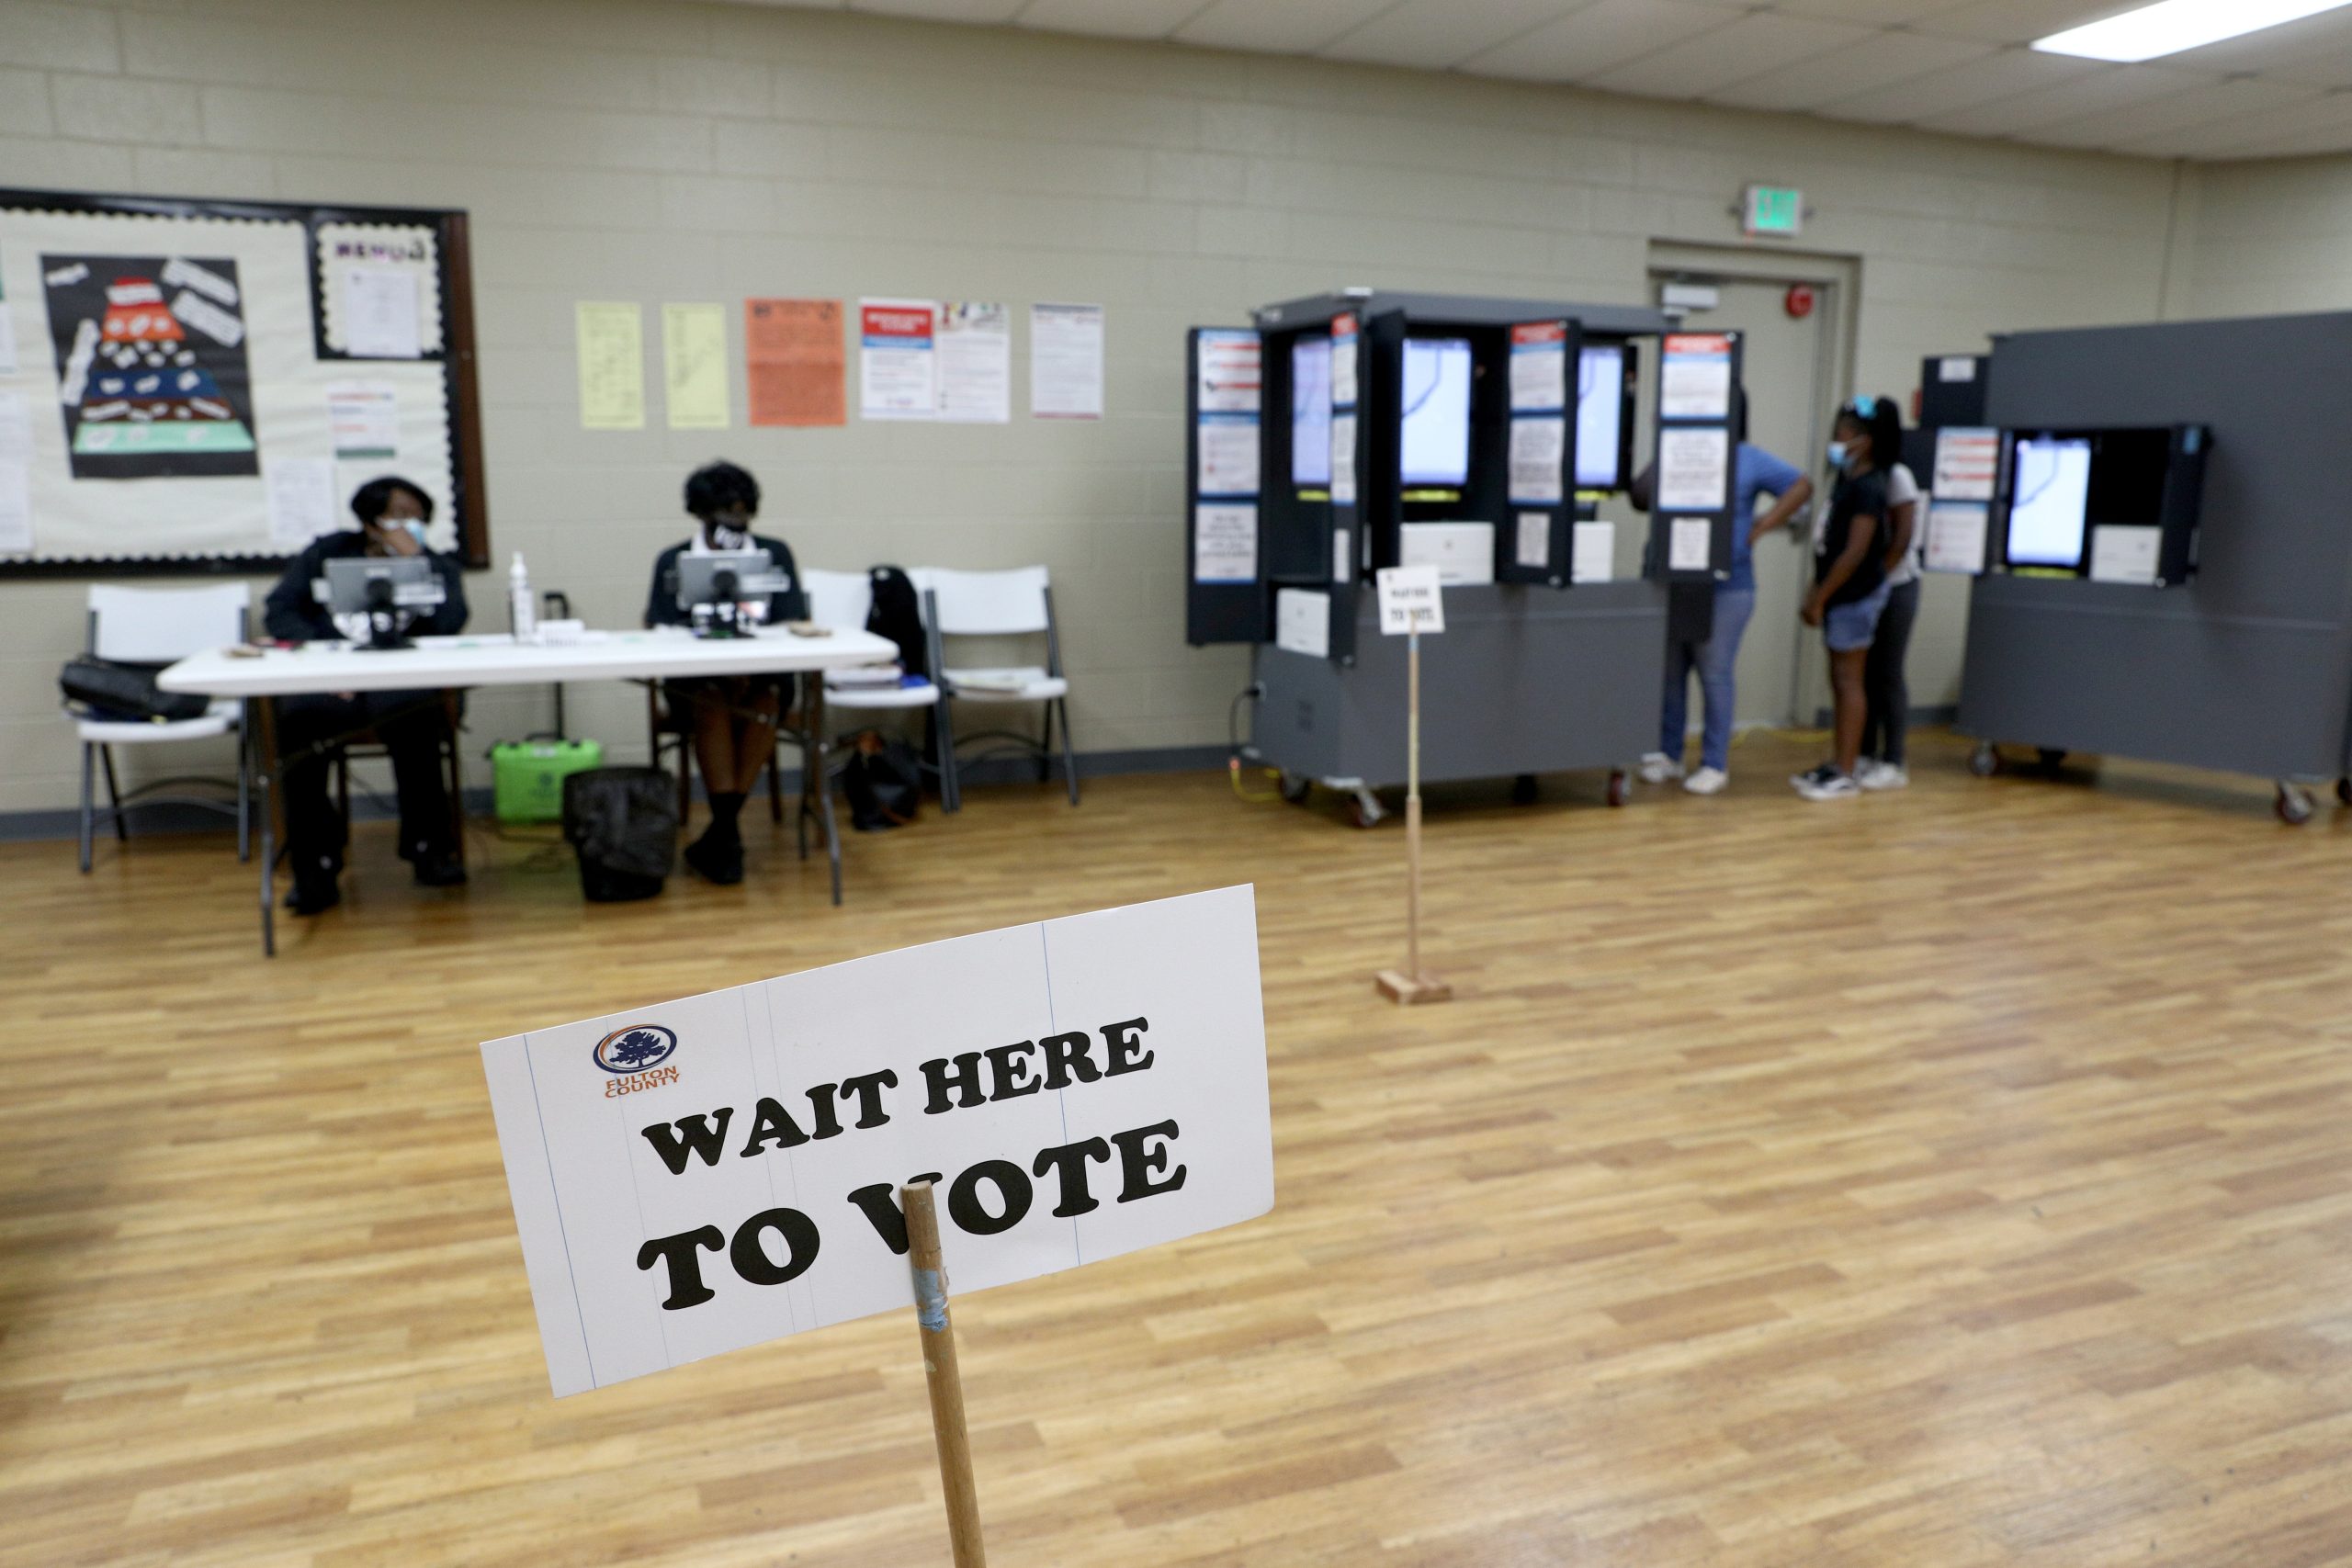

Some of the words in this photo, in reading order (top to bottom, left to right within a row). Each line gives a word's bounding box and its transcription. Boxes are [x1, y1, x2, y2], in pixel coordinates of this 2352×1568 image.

[605, 1073, 680, 1098] COUNTY
[606, 1066, 677, 1089] FULTON
[641, 1068, 899, 1176] WAIT
[919, 1016, 1155, 1115] HERE
[636, 1207, 820, 1311] TO
[847, 1119, 1187, 1255] VOTE
